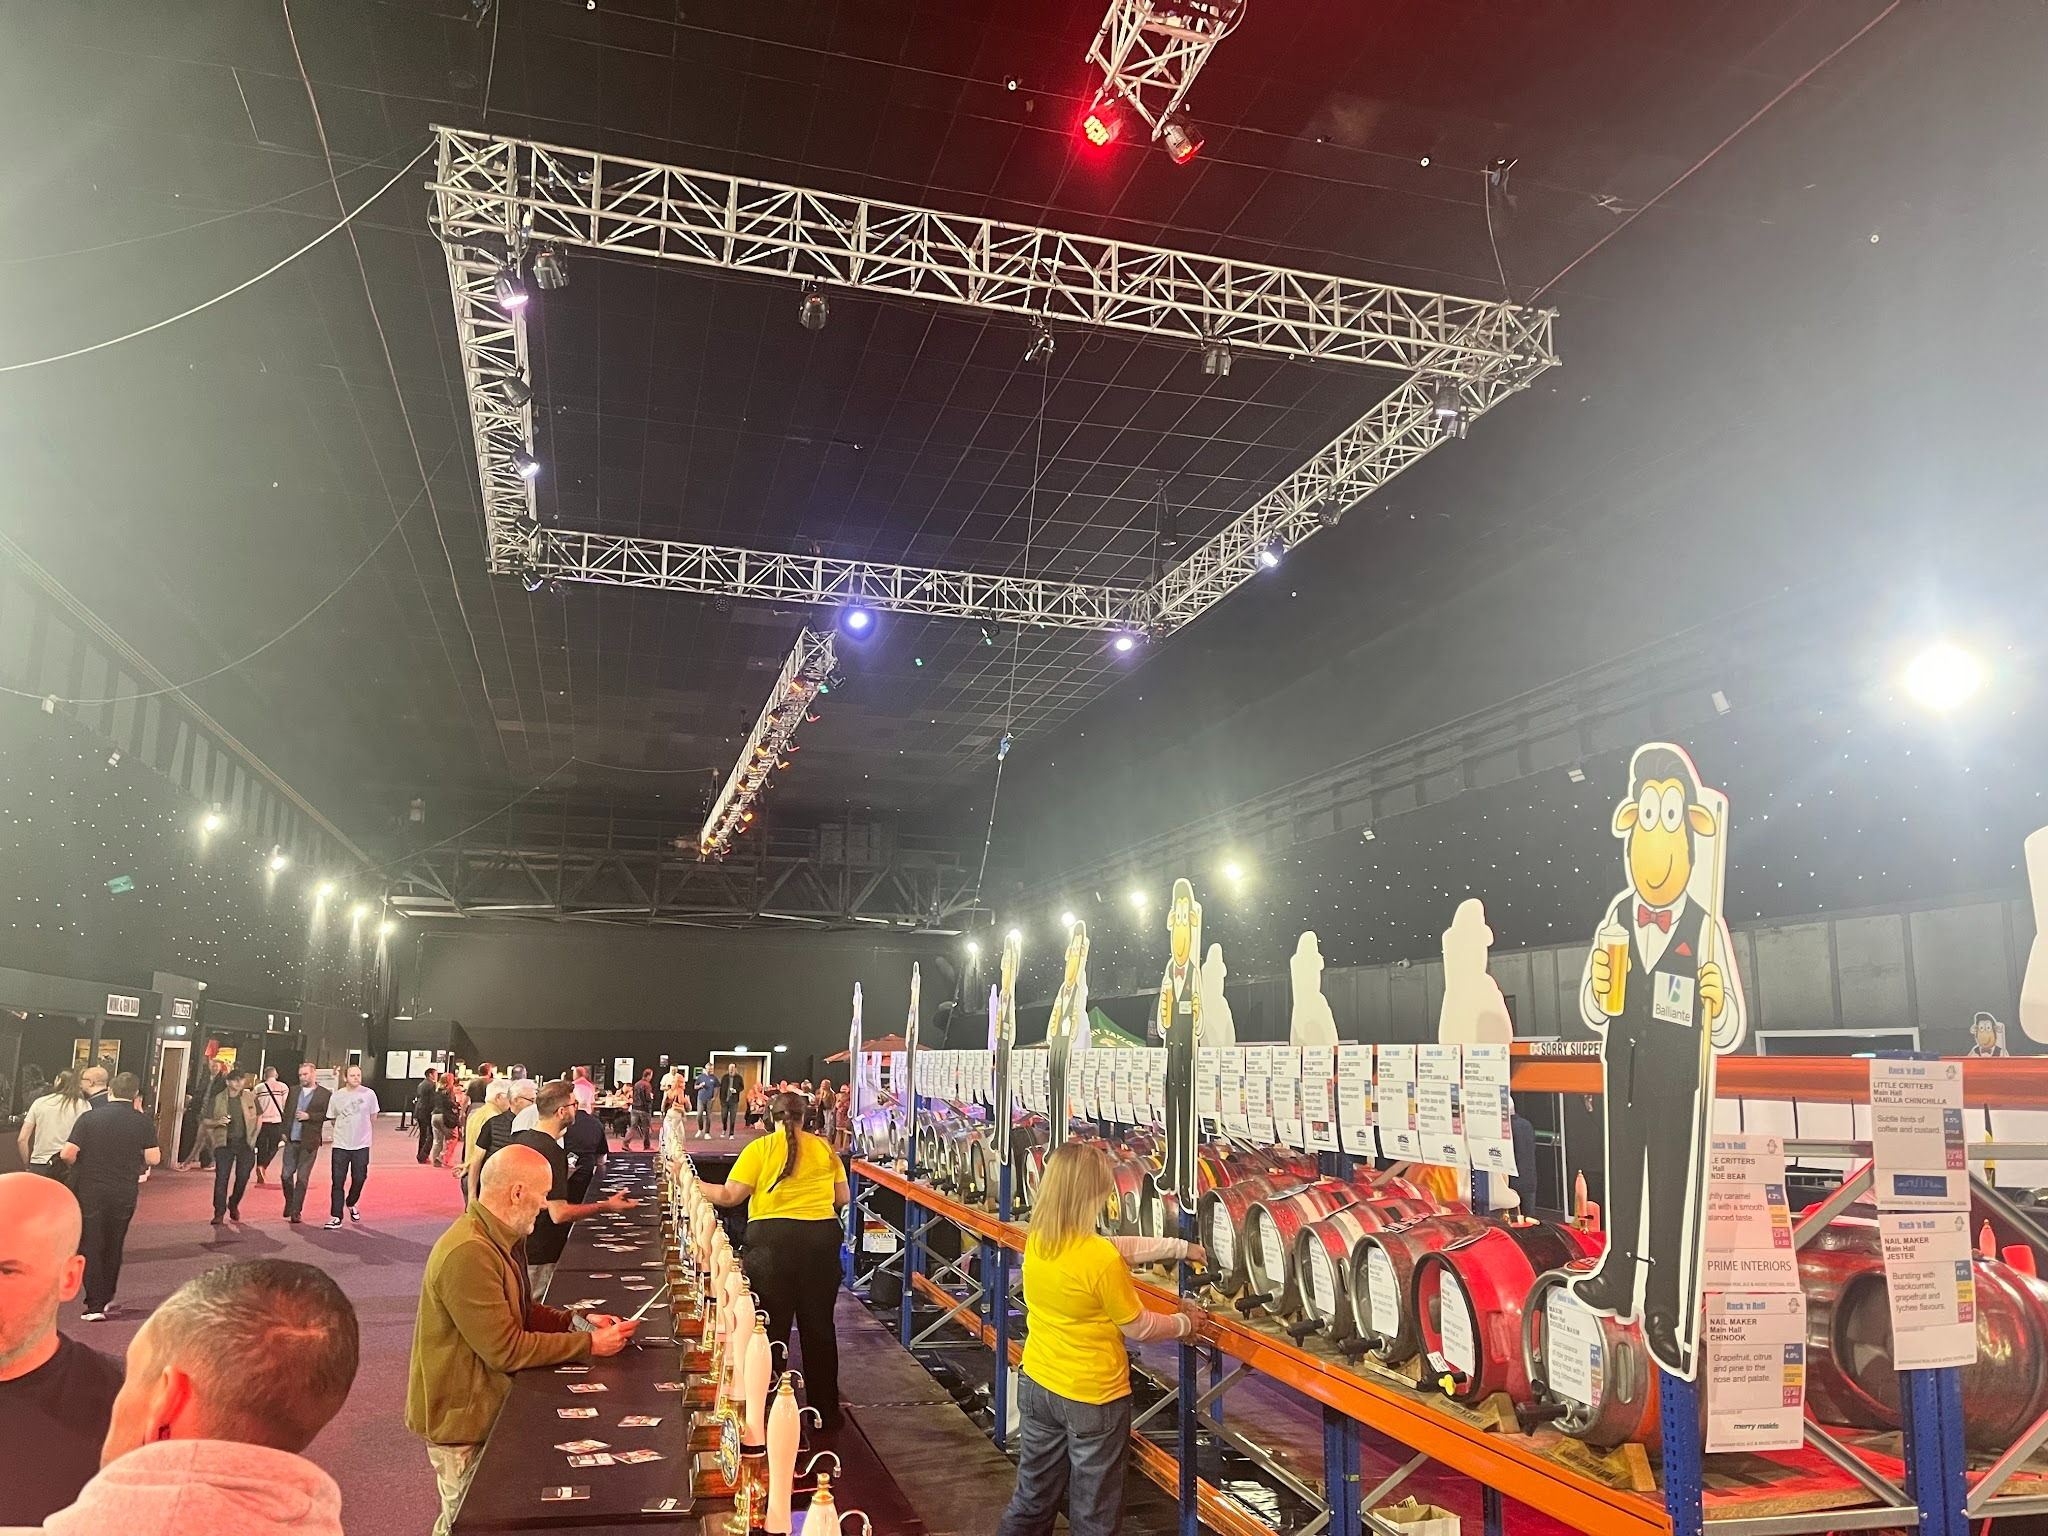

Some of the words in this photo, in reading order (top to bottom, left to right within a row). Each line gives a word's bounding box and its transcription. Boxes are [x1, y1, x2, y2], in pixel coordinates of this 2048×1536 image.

[1541, 1042, 1569, 1055] SORRY
[1898, 1082, 1933, 1090] CRITTERS
[1904, 1097, 1947, 1105] CHINCHILLA
[1877, 1115, 1898, 1123] Subtle
[1900, 1115, 1916, 1123] hints
[1917, 1115, 1925, 1123] of
[1877, 1125, 1898, 1134] coffee
[1900, 1125, 1912, 1134] and
[1914, 1125, 1941, 1134] custard.
[1720, 1157, 1756, 1165] CRITTERS
[1903, 1236, 1930, 1244] MAKER
[1887, 1252, 1915, 1260] JESTER
[1707, 1260, 1739, 1271] PRIME
[1740, 1260, 1792, 1271] INTERIORS
[1892, 1272, 1921, 1281] Bursting
[1922, 1271, 1936, 1279] with
[1893, 1282, 1937, 1291] blackcurrant,
[1895, 1292, 1927, 1303] grapefruit
[1928, 1292, 1941, 1300] and
[1727, 1302, 1744, 1310] Rock
[1752, 1302, 1766, 1310] Roll
[1896, 1303, 1918, 1313] lychee
[1919, 1302, 1946, 1311] flavours.
[1713, 1353, 1751, 1362] Grapefruit,
[1713, 1365, 1727, 1373] and
[1728, 1365, 1744, 1373] pine
[1732, 1375, 1746, 1383] and
[1747, 1375, 1772, 1384] palate.
[1733, 1423, 1755, 1431] merry
[1756, 1422, 1779, 1430] maids
